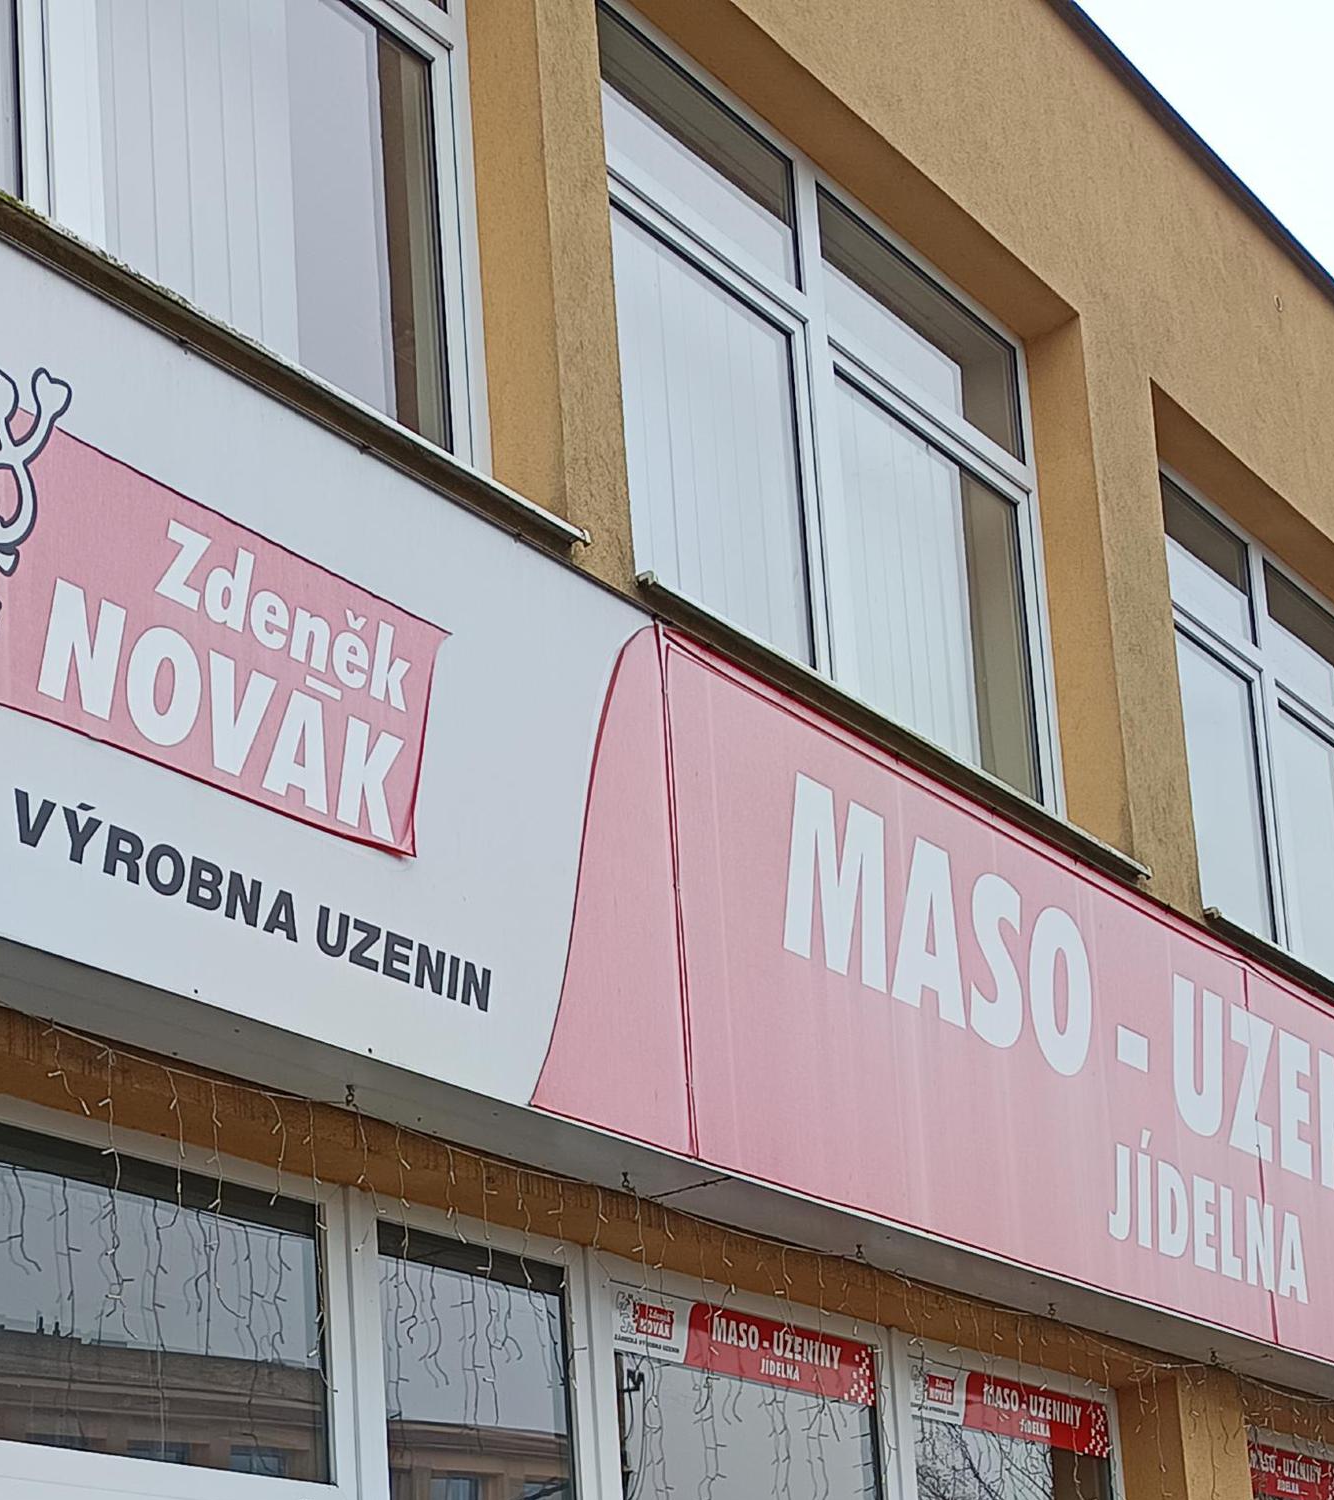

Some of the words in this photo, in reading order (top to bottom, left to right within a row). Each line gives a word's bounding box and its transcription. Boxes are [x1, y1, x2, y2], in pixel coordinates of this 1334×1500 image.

[154, 519, 414, 715] Zdeněk
[37, 578, 405, 844] NOVÁK
[14, 788, 299, 944] VÝROBNA
[315, 904, 493, 1014] UZENIN
[782, 771, 1093, 1078] MASO
[1109, 1128, 1310, 1306] JÍDELNA
[712, 1316, 759, 1351] MASO
[773, 1331, 841, 1369] UZENINY
[760, 1355, 800, 1381] JÍDELNA
[1029, 1394, 1082, 1426] UZENINY
